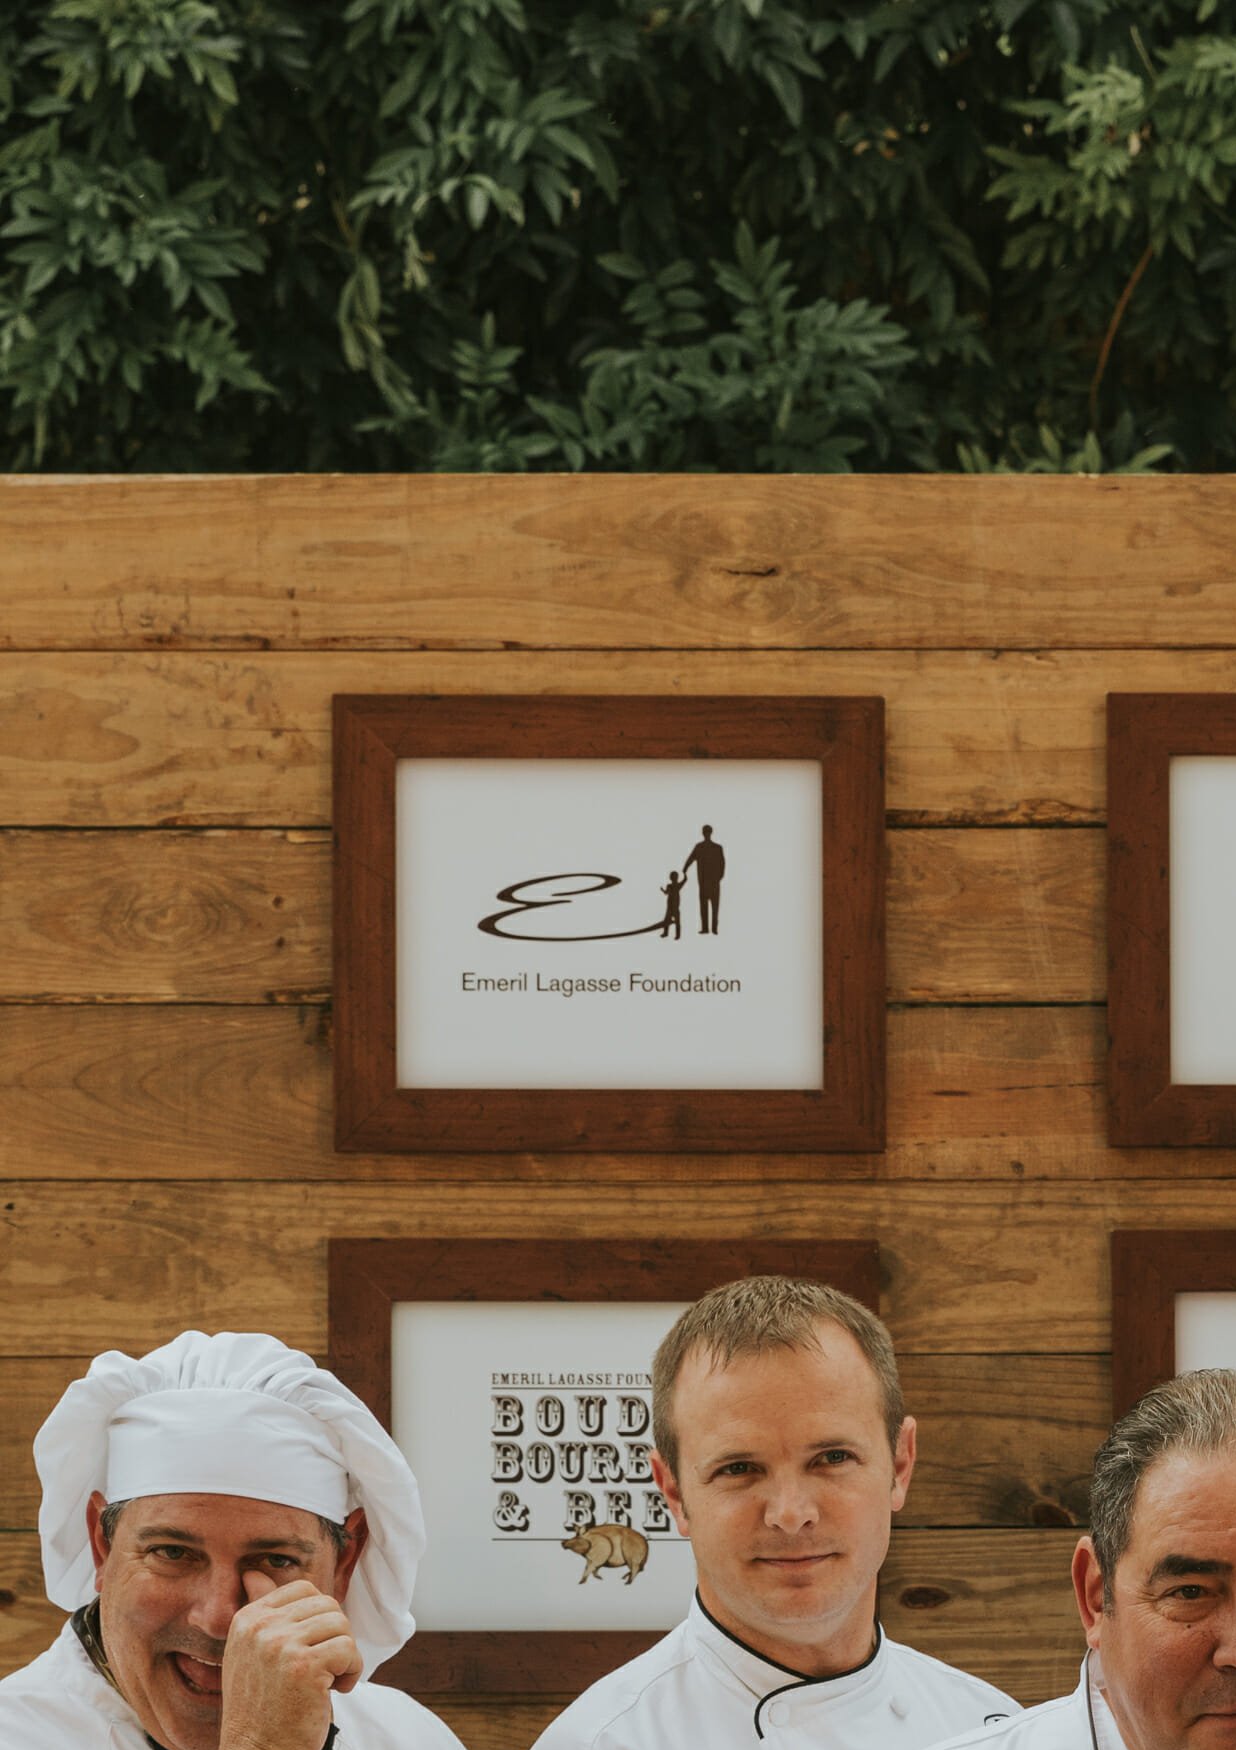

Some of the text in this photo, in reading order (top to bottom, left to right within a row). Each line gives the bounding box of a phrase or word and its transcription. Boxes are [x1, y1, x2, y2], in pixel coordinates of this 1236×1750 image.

[462, 972, 741, 998] Emeril Lagasse Foundation
[491, 1373, 544, 1386] EMERIL
[549, 1373, 612, 1386] LAGASSE
[491, 1395, 650, 1437] BOUD
[491, 1441, 655, 1483] BOURB
[493, 1490, 670, 1532] & BEE
